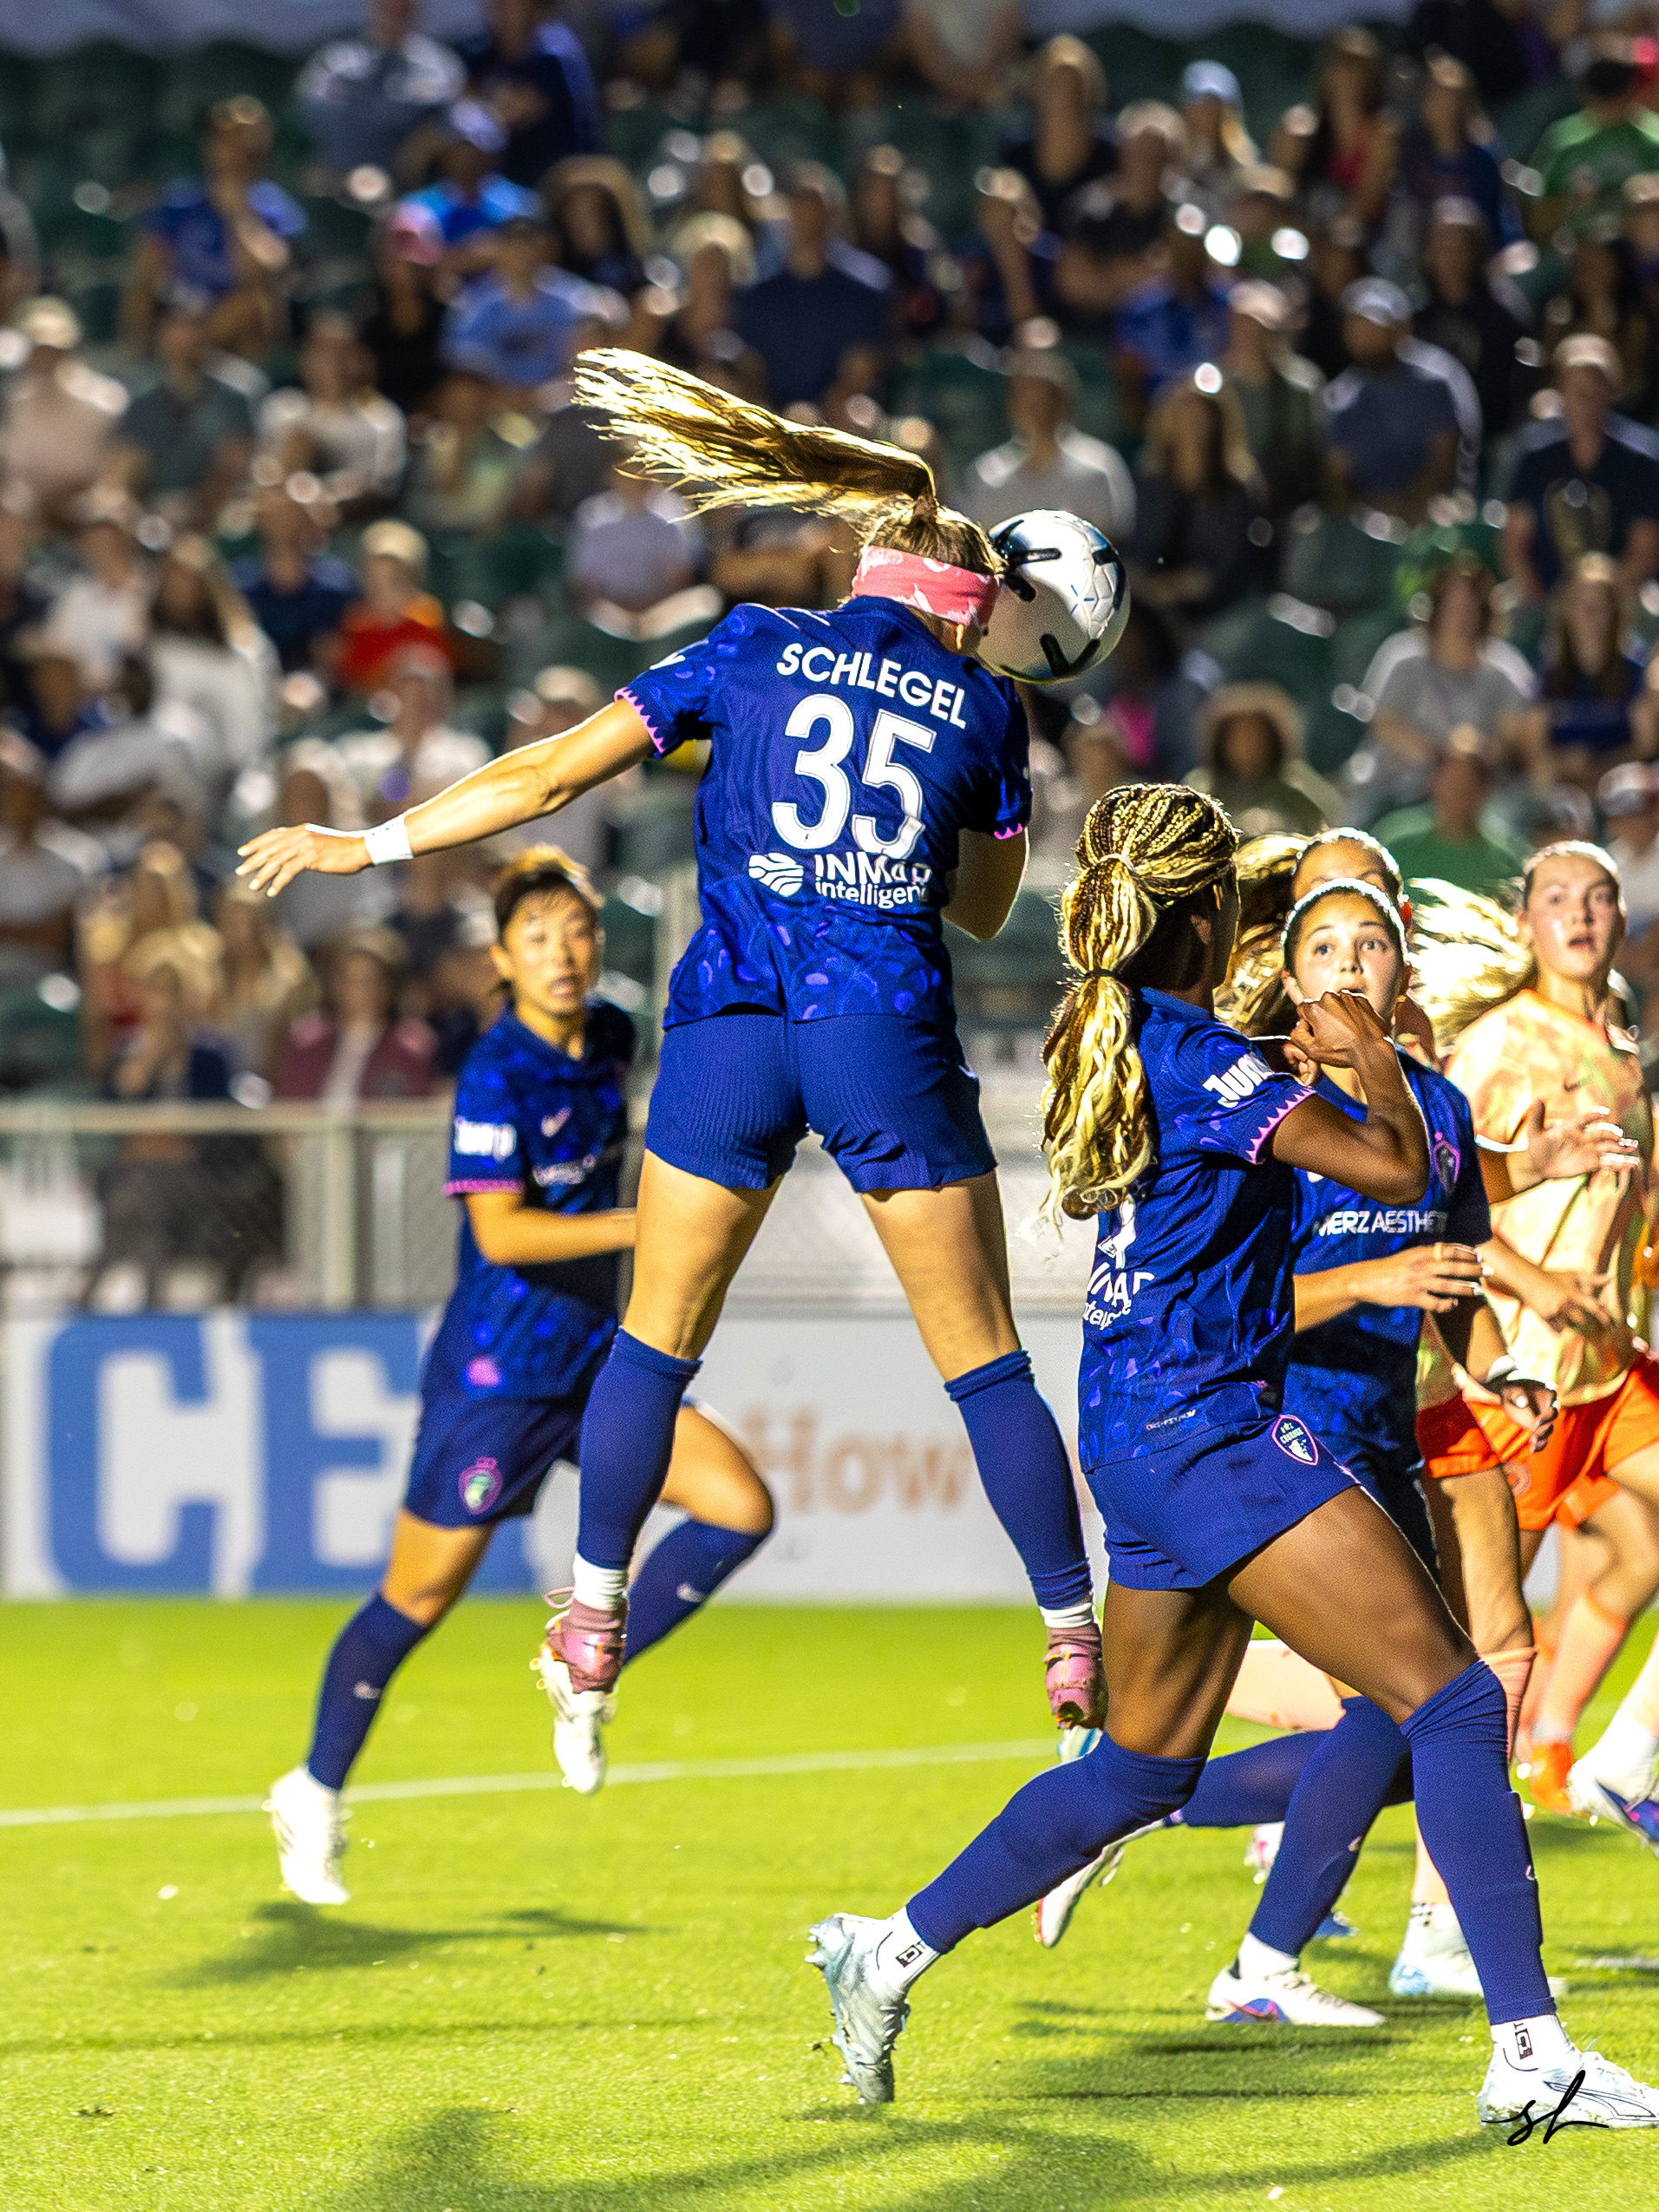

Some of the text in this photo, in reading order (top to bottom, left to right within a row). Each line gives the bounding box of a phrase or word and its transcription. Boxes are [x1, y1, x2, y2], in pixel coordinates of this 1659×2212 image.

[776, 643, 967, 730] SCHLEGEL
[771, 693, 937, 860] 35
[814, 877, 930, 909] intelligen
